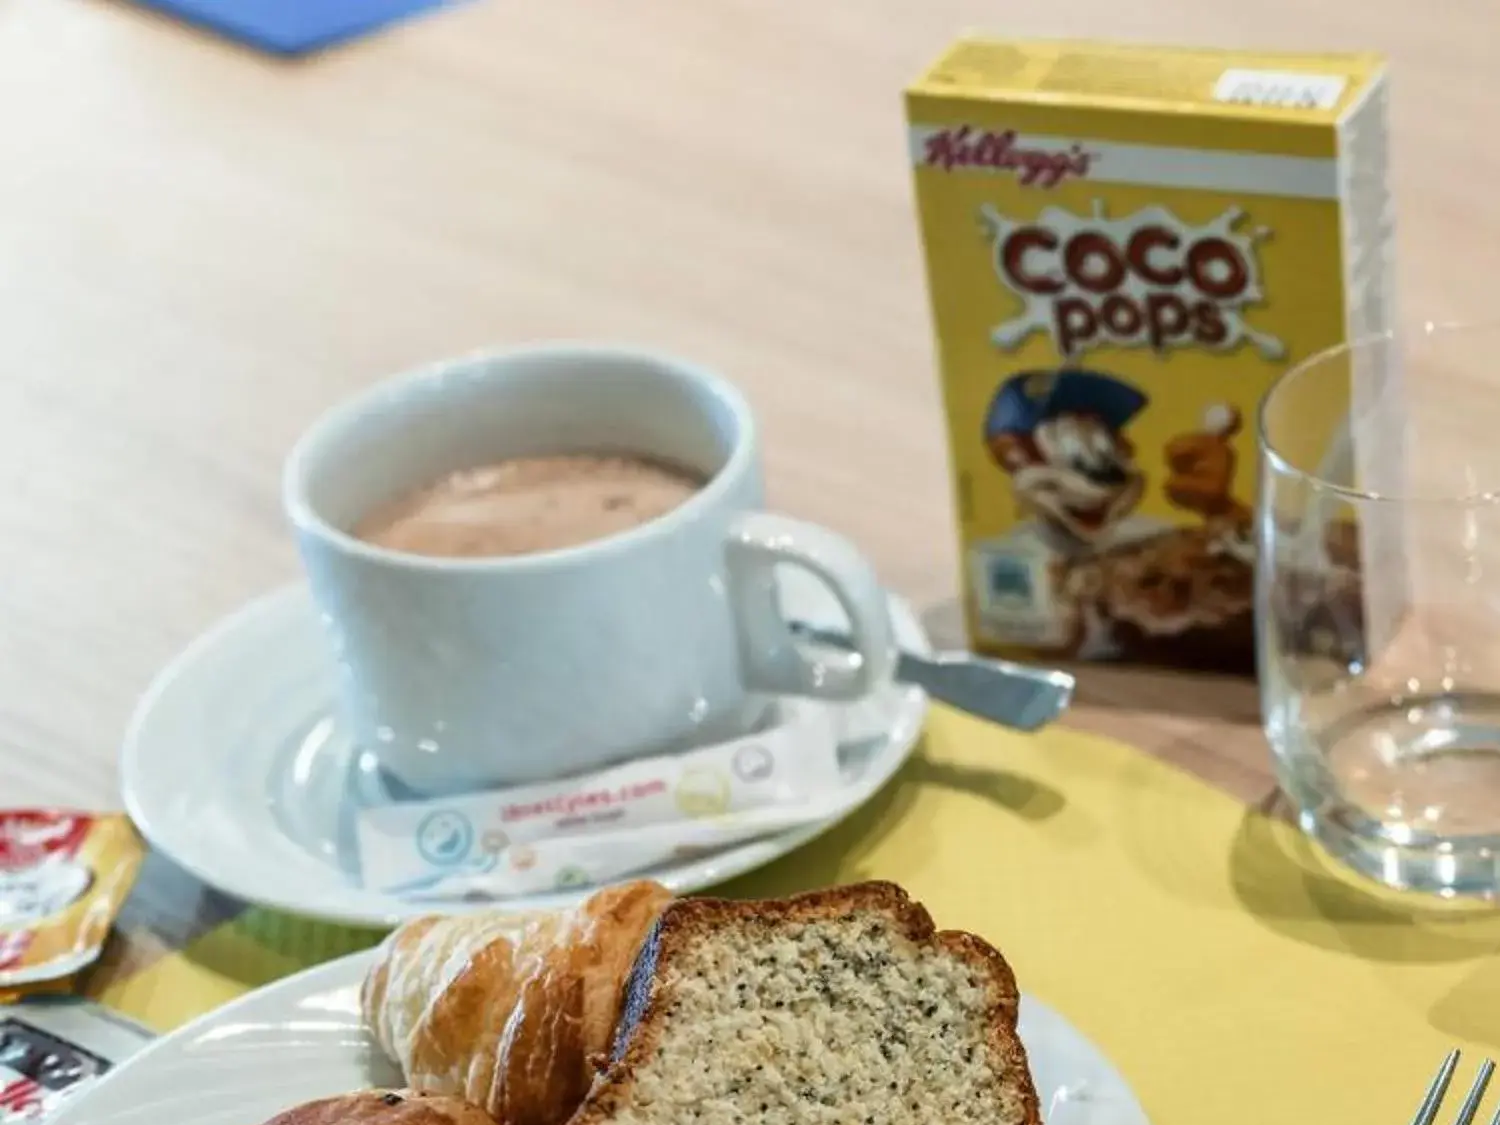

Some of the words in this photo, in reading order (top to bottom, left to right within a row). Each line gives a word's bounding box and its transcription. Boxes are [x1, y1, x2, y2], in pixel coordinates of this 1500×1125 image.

[925, 124, 1090, 188] Kellogg's
[1001, 224, 1248, 298] COCO
[1057, 293, 1227, 354] pops
